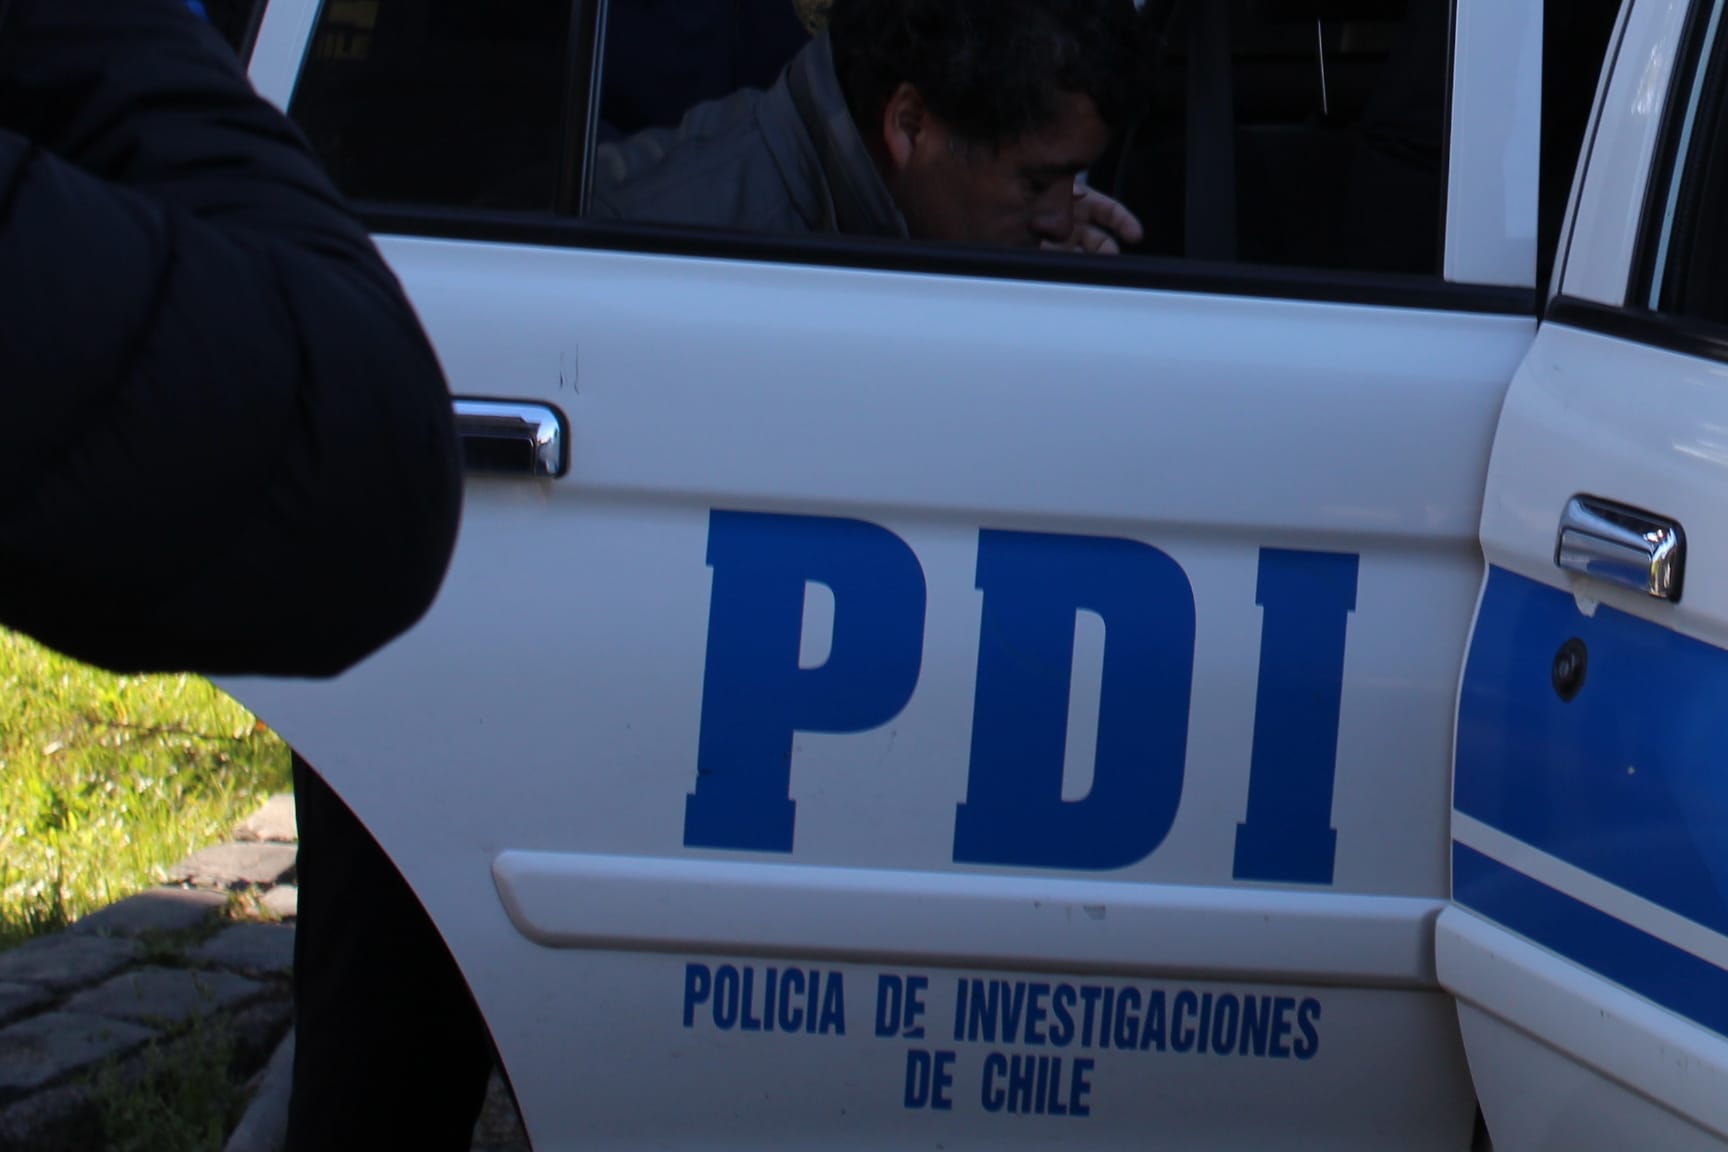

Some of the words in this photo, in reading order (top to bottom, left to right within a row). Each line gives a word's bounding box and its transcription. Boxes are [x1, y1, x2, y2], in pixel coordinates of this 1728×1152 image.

[682, 508, 1360, 884] PDI
[683, 962, 845, 1036] POLICIA
[875, 973, 929, 1040] DE
[954, 978, 1322, 1061] INVESTIGACIONES
[903, 1049, 956, 1111] DE
[981, 1052, 1095, 1117] CHILE
